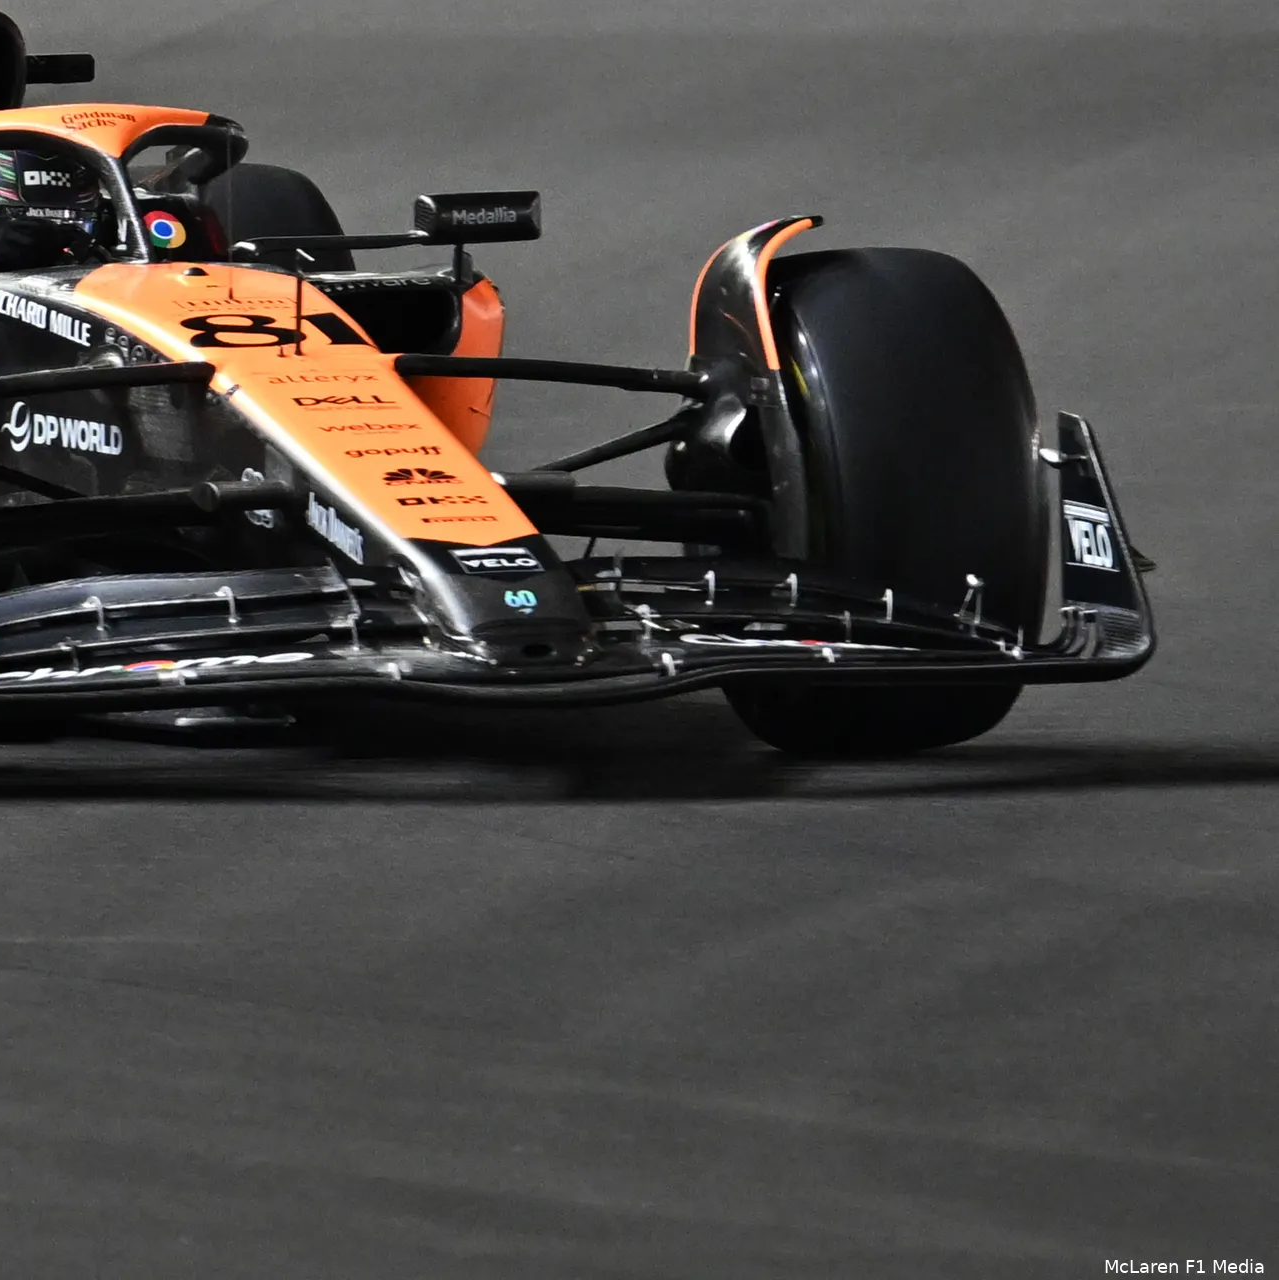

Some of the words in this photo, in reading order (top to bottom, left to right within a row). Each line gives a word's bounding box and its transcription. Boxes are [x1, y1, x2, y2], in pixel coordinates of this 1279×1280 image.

[61, 111, 137, 124] Goldman
[23, 170, 72, 188] OKX
[451, 206, 518, 225] Medallia
[49, 310, 92, 348] MILLE
[180, 312, 380, 348] 81
[268, 373, 380, 385] alteryx
[292, 394, 397, 407] DELL
[33, 413, 59, 446] DP
[59, 416, 123, 456] WORLD
[318, 422, 423, 433] webex
[344, 445, 443, 459] gopuff
[1067, 518, 1114, 569] VELO
[461, 557, 539, 568] VELO
